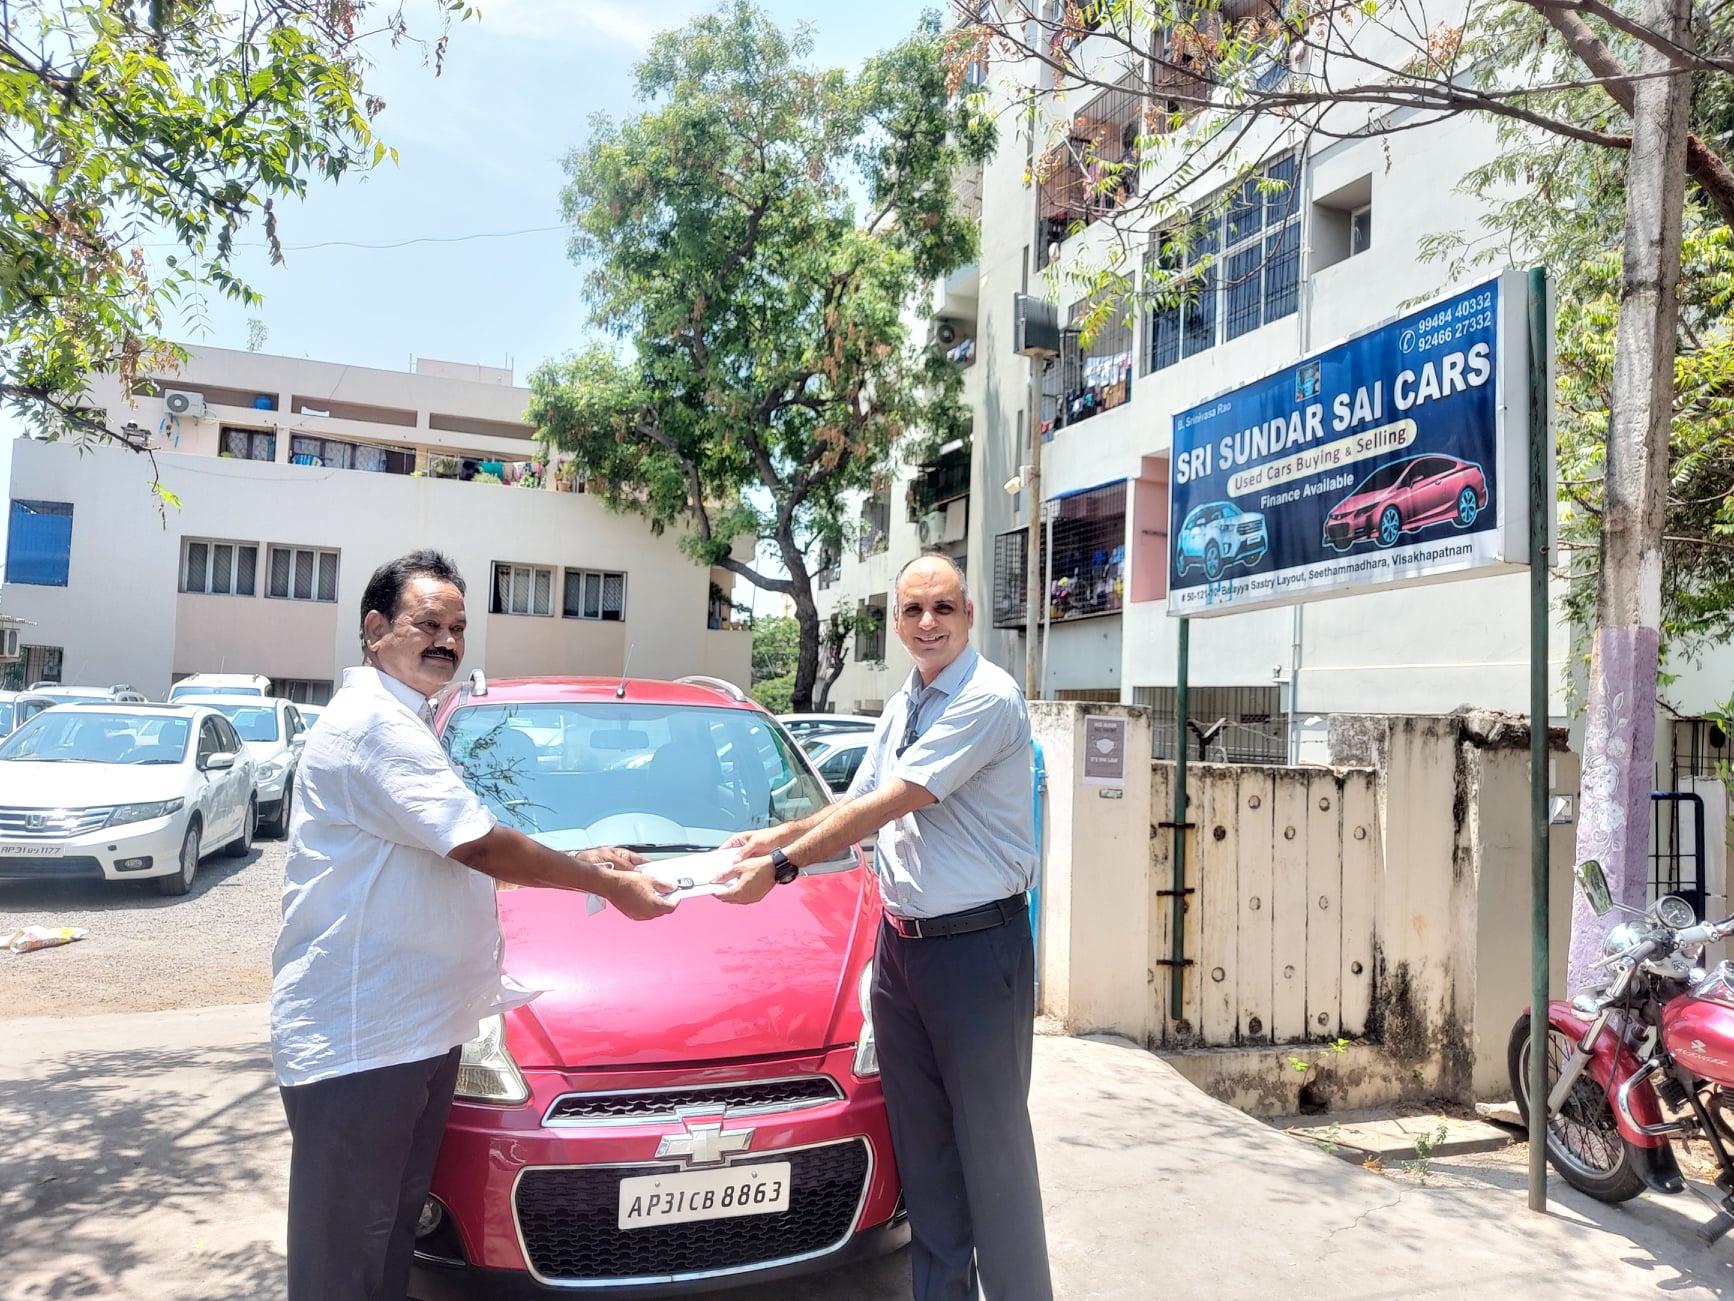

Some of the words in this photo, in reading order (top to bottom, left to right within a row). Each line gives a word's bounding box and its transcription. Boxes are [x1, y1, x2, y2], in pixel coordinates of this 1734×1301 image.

[1418, 308, 1452, 334] 99484
[1455, 292, 1491, 317] 40332
[1418, 327, 1452, 352] 92466
[1455, 311, 1491, 338] 27332
[1176, 443, 1212, 485] SRI
[1218, 403, 1324, 470] SUNDAR
[1332, 380, 1382, 432] SAI
[1394, 342, 1491, 411] CARS
[1217, 402, 1232, 416] Rao
[1235, 472, 1262, 490] Used
[1267, 462, 1292, 481] Cars
[1296, 448, 1340, 472] Buying
[1345, 446, 1352, 457] &
[1357, 427, 1407, 453] Selling
[1260, 488, 1300, 510] Finance
[1303, 473, 1354, 498] Available
[1251, 578, 1275, 592] Sastry
[1276, 571, 1307, 587] Layout,
[1308, 557, 1390, 581] Seethammadhara,
[1392, 543, 1473, 566] Visakhapatnam
[721, 1180, 782, 1208] 8863
